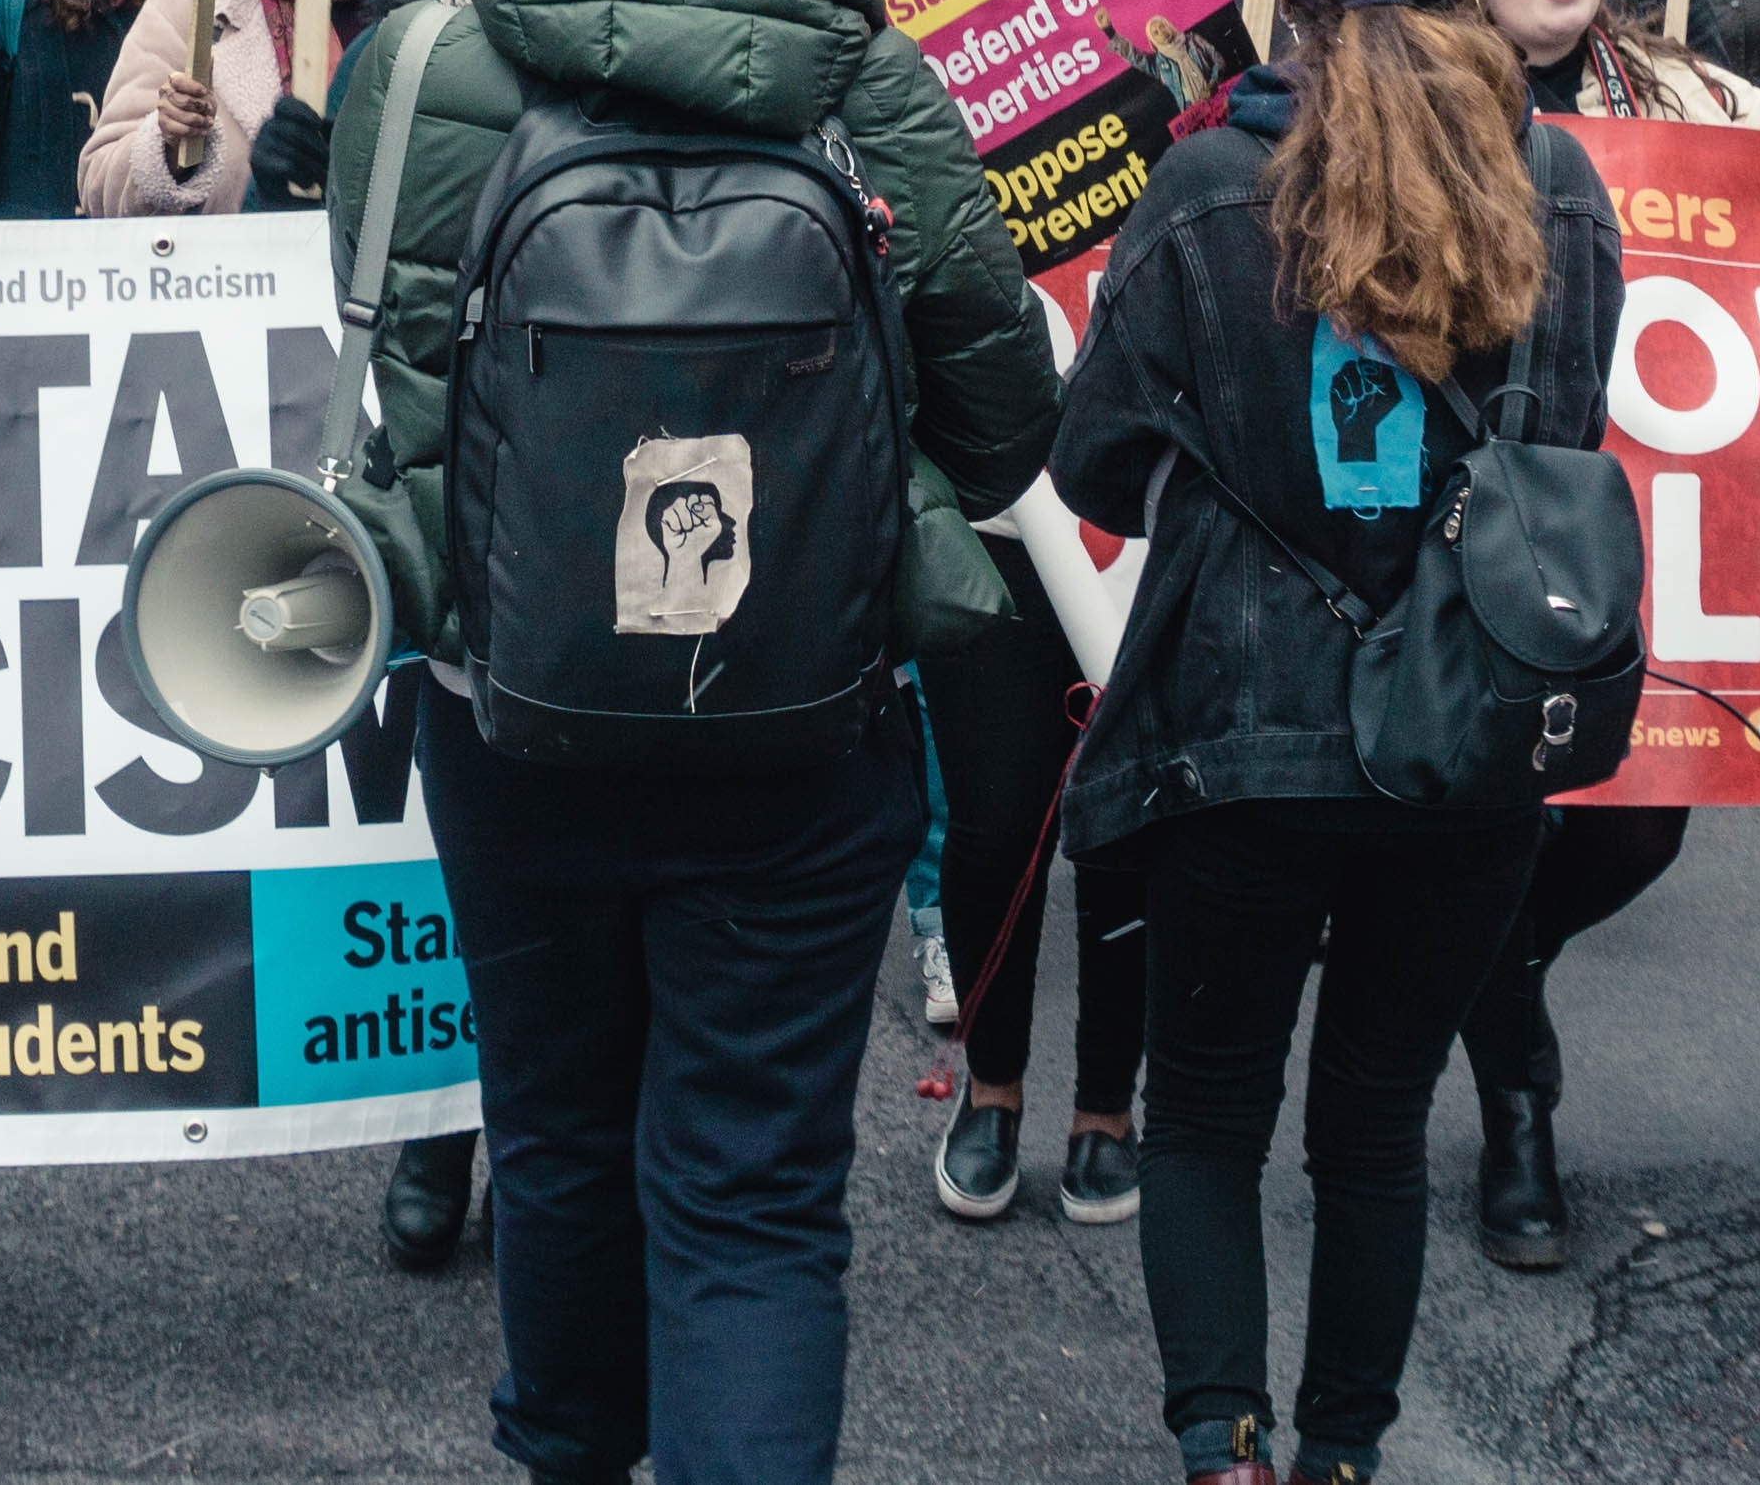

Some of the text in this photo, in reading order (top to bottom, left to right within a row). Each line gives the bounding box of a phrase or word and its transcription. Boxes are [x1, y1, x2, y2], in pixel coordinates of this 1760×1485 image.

[40, 269, 86, 311] Up
[98, 267, 137, 302] To
[150, 264, 276, 299] Racism
